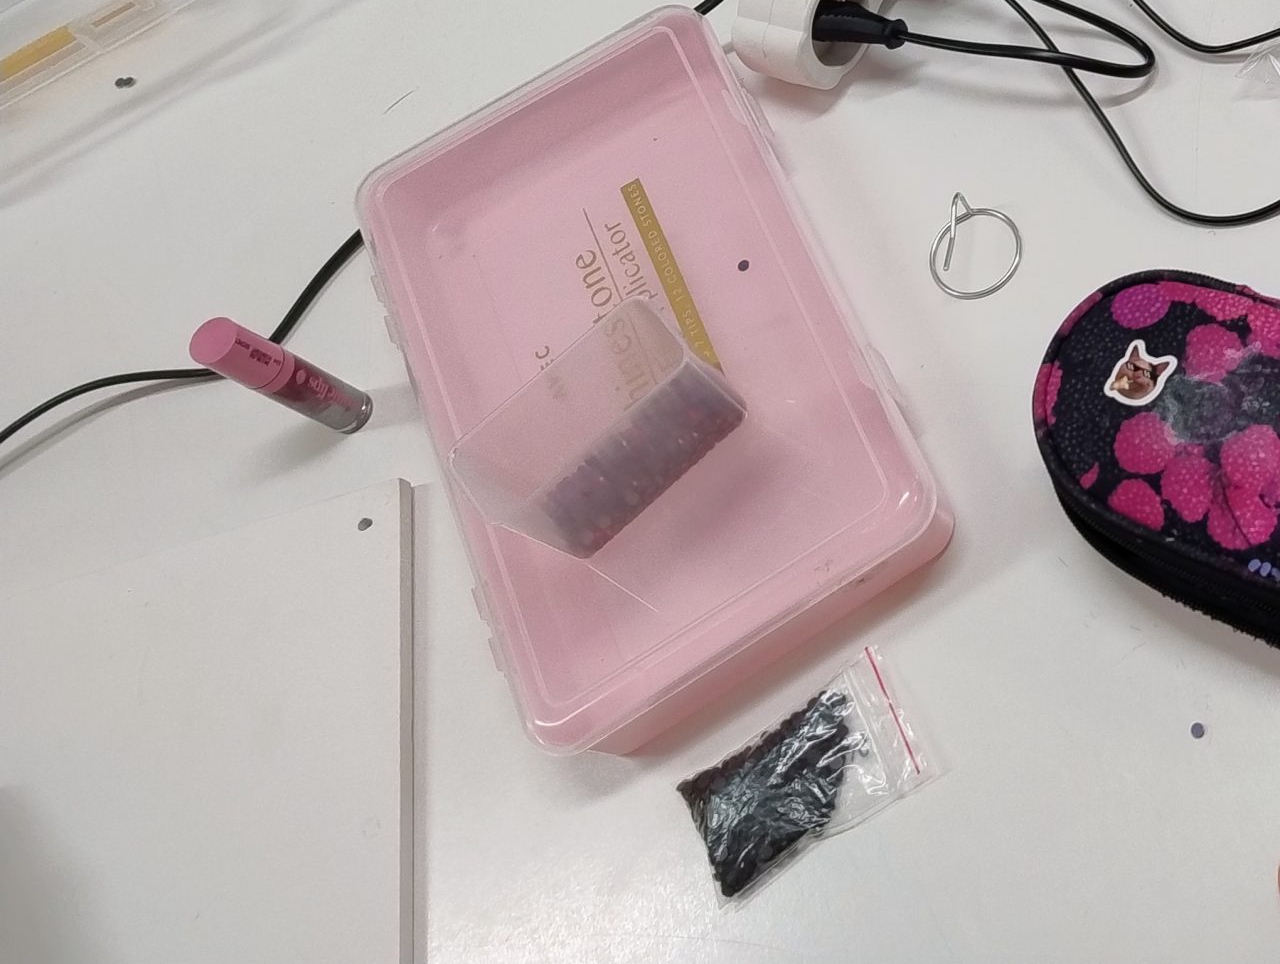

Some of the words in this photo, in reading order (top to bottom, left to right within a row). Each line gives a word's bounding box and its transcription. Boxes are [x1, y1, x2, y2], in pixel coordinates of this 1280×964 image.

[627, 183, 652, 227] STONES
[604, 221, 659, 301] plicator
[648, 230, 678, 284] COLORED
[673, 287, 684, 302] 12
[682, 309, 699, 336] TIPS
